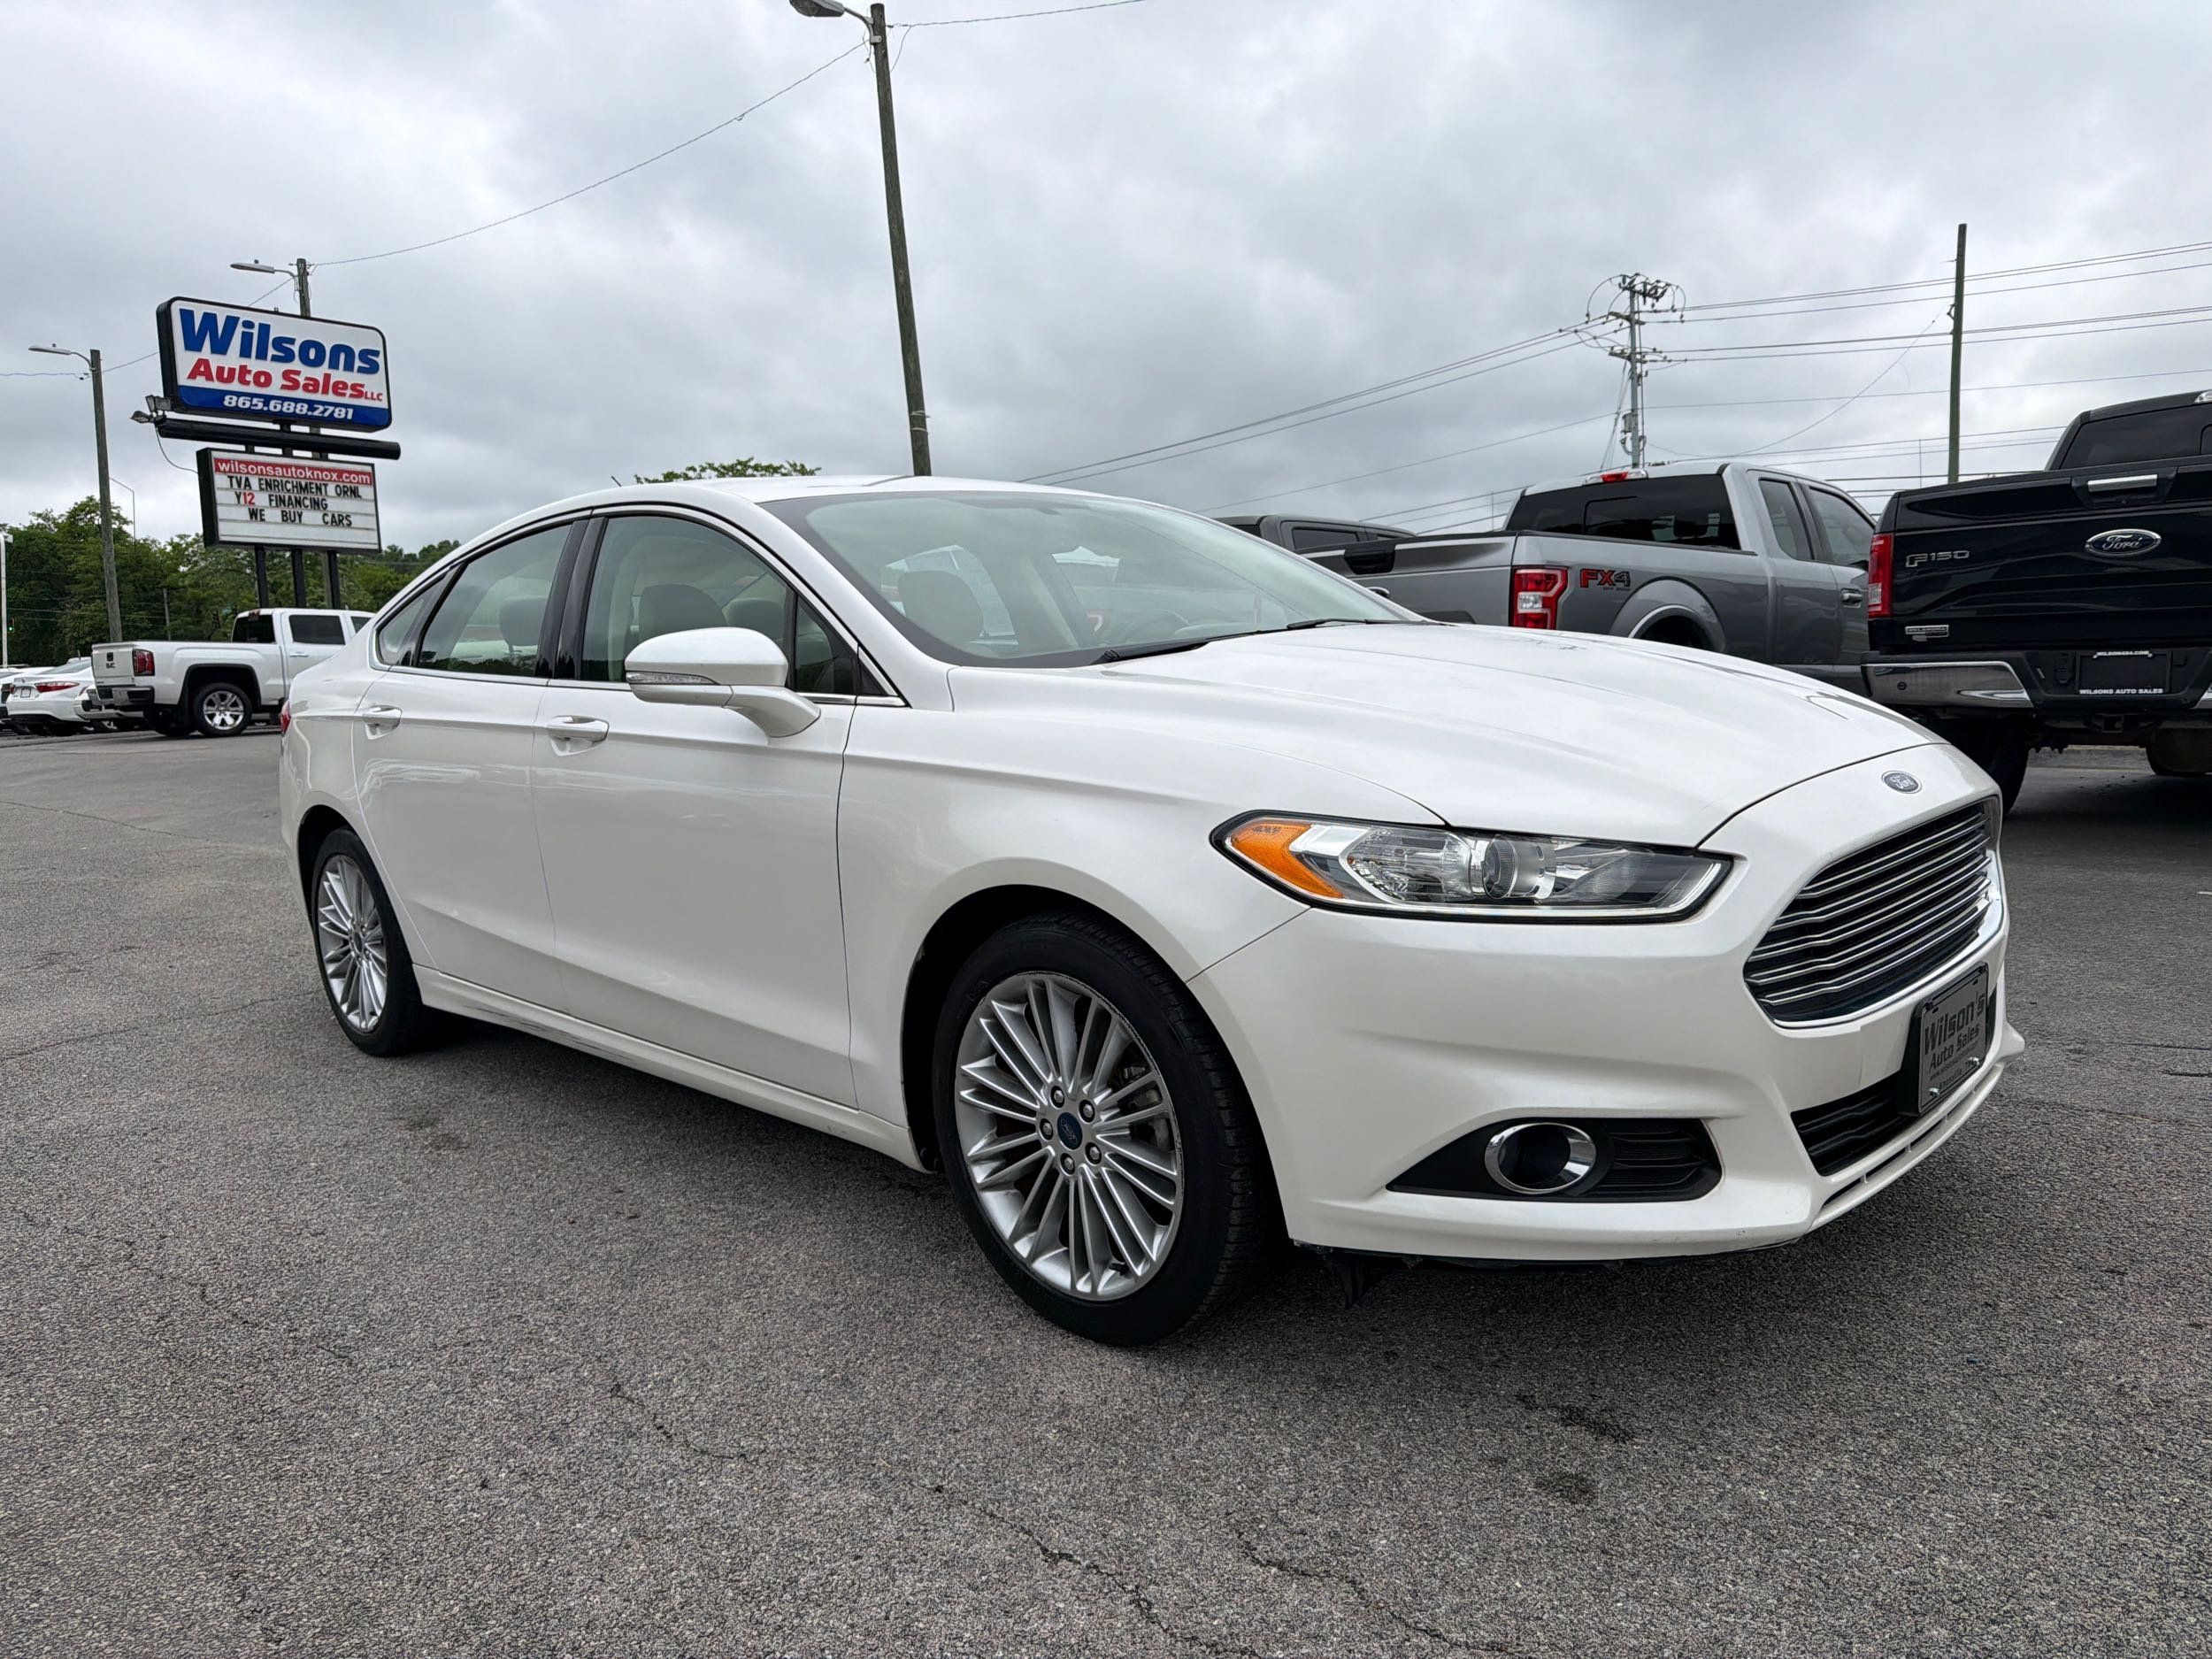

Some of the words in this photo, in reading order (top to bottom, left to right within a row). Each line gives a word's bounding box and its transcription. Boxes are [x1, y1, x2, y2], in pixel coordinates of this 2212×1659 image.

[179, 308, 380, 375] Wilsons
[187, 357, 273, 388] Auto
[280, 369, 365, 399] Sales
[364, 390, 383, 402] LLC
[223, 395, 354, 419] 865.688.2781
[218, 461, 371, 484] wilsonsautoknox.com
[227, 475, 252, 491] TVA
[258, 478, 329, 495] ENRICHMENT
[335, 484, 362, 499] ORNL
[234, 492, 256, 506] Y12
[268, 494, 328, 511] FINANCING
[249, 507, 265, 522] WE
[281, 510, 303, 524] BUY
[322, 512, 352, 526] CARS
[2102, 534, 2143, 550] Ford
[1579, 568, 1631, 588] FX4
[1924, 991, 1985, 1055] Wilson's
[1929, 1044, 1954, 1071] Auto
[1956, 1023, 1980, 1052] Sales
